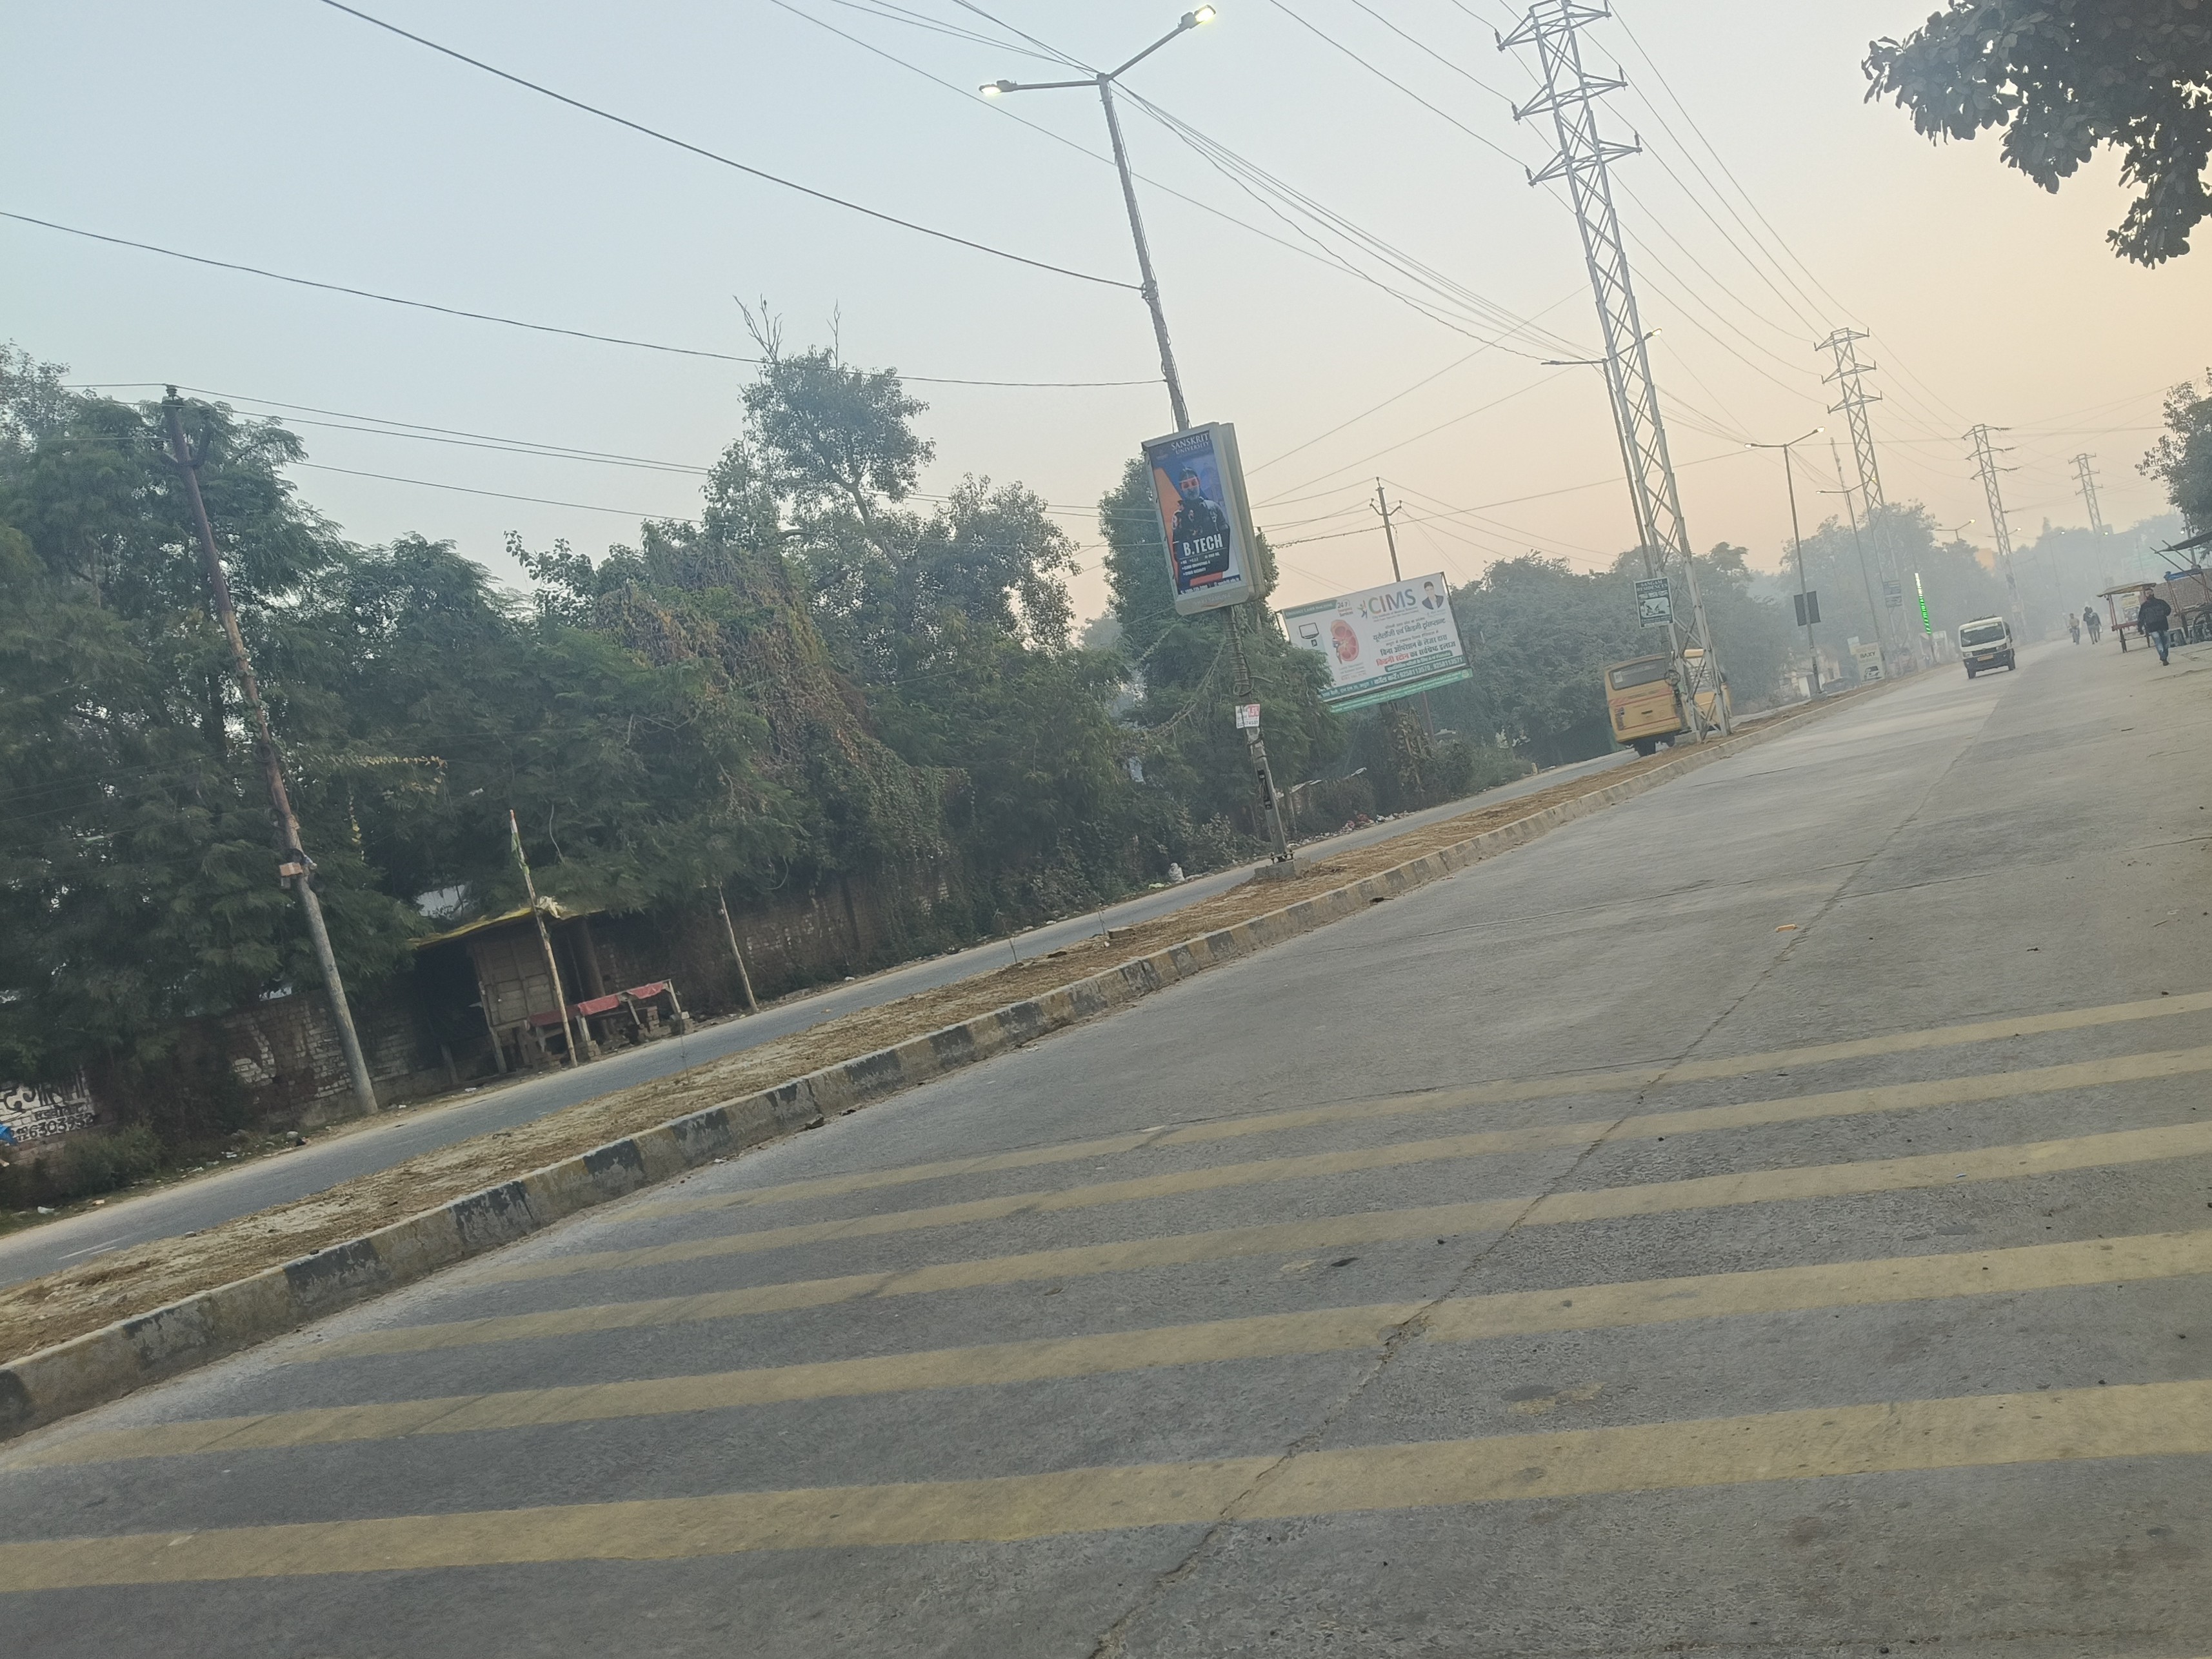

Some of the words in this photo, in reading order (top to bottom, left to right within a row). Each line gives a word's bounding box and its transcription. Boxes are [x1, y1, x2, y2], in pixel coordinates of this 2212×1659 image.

[1175, 441, 1210, 454] UNIVERSITY
[1183, 533, 1222, 556] B.TECH
[1368, 588, 1416, 614] CIMS
[1376, 655, 1394, 666] किडनी
[1395, 651, 1409, 661] स्टोन
[1439, 641, 1456, 650] इलाज
[1380, 647, 1393, 655] बिना
[1393, 641, 1417, 652] ऑपरेशन
[1423, 636, 1436, 644] लेजर
[1373, 675, 1387, 684] कॉल
